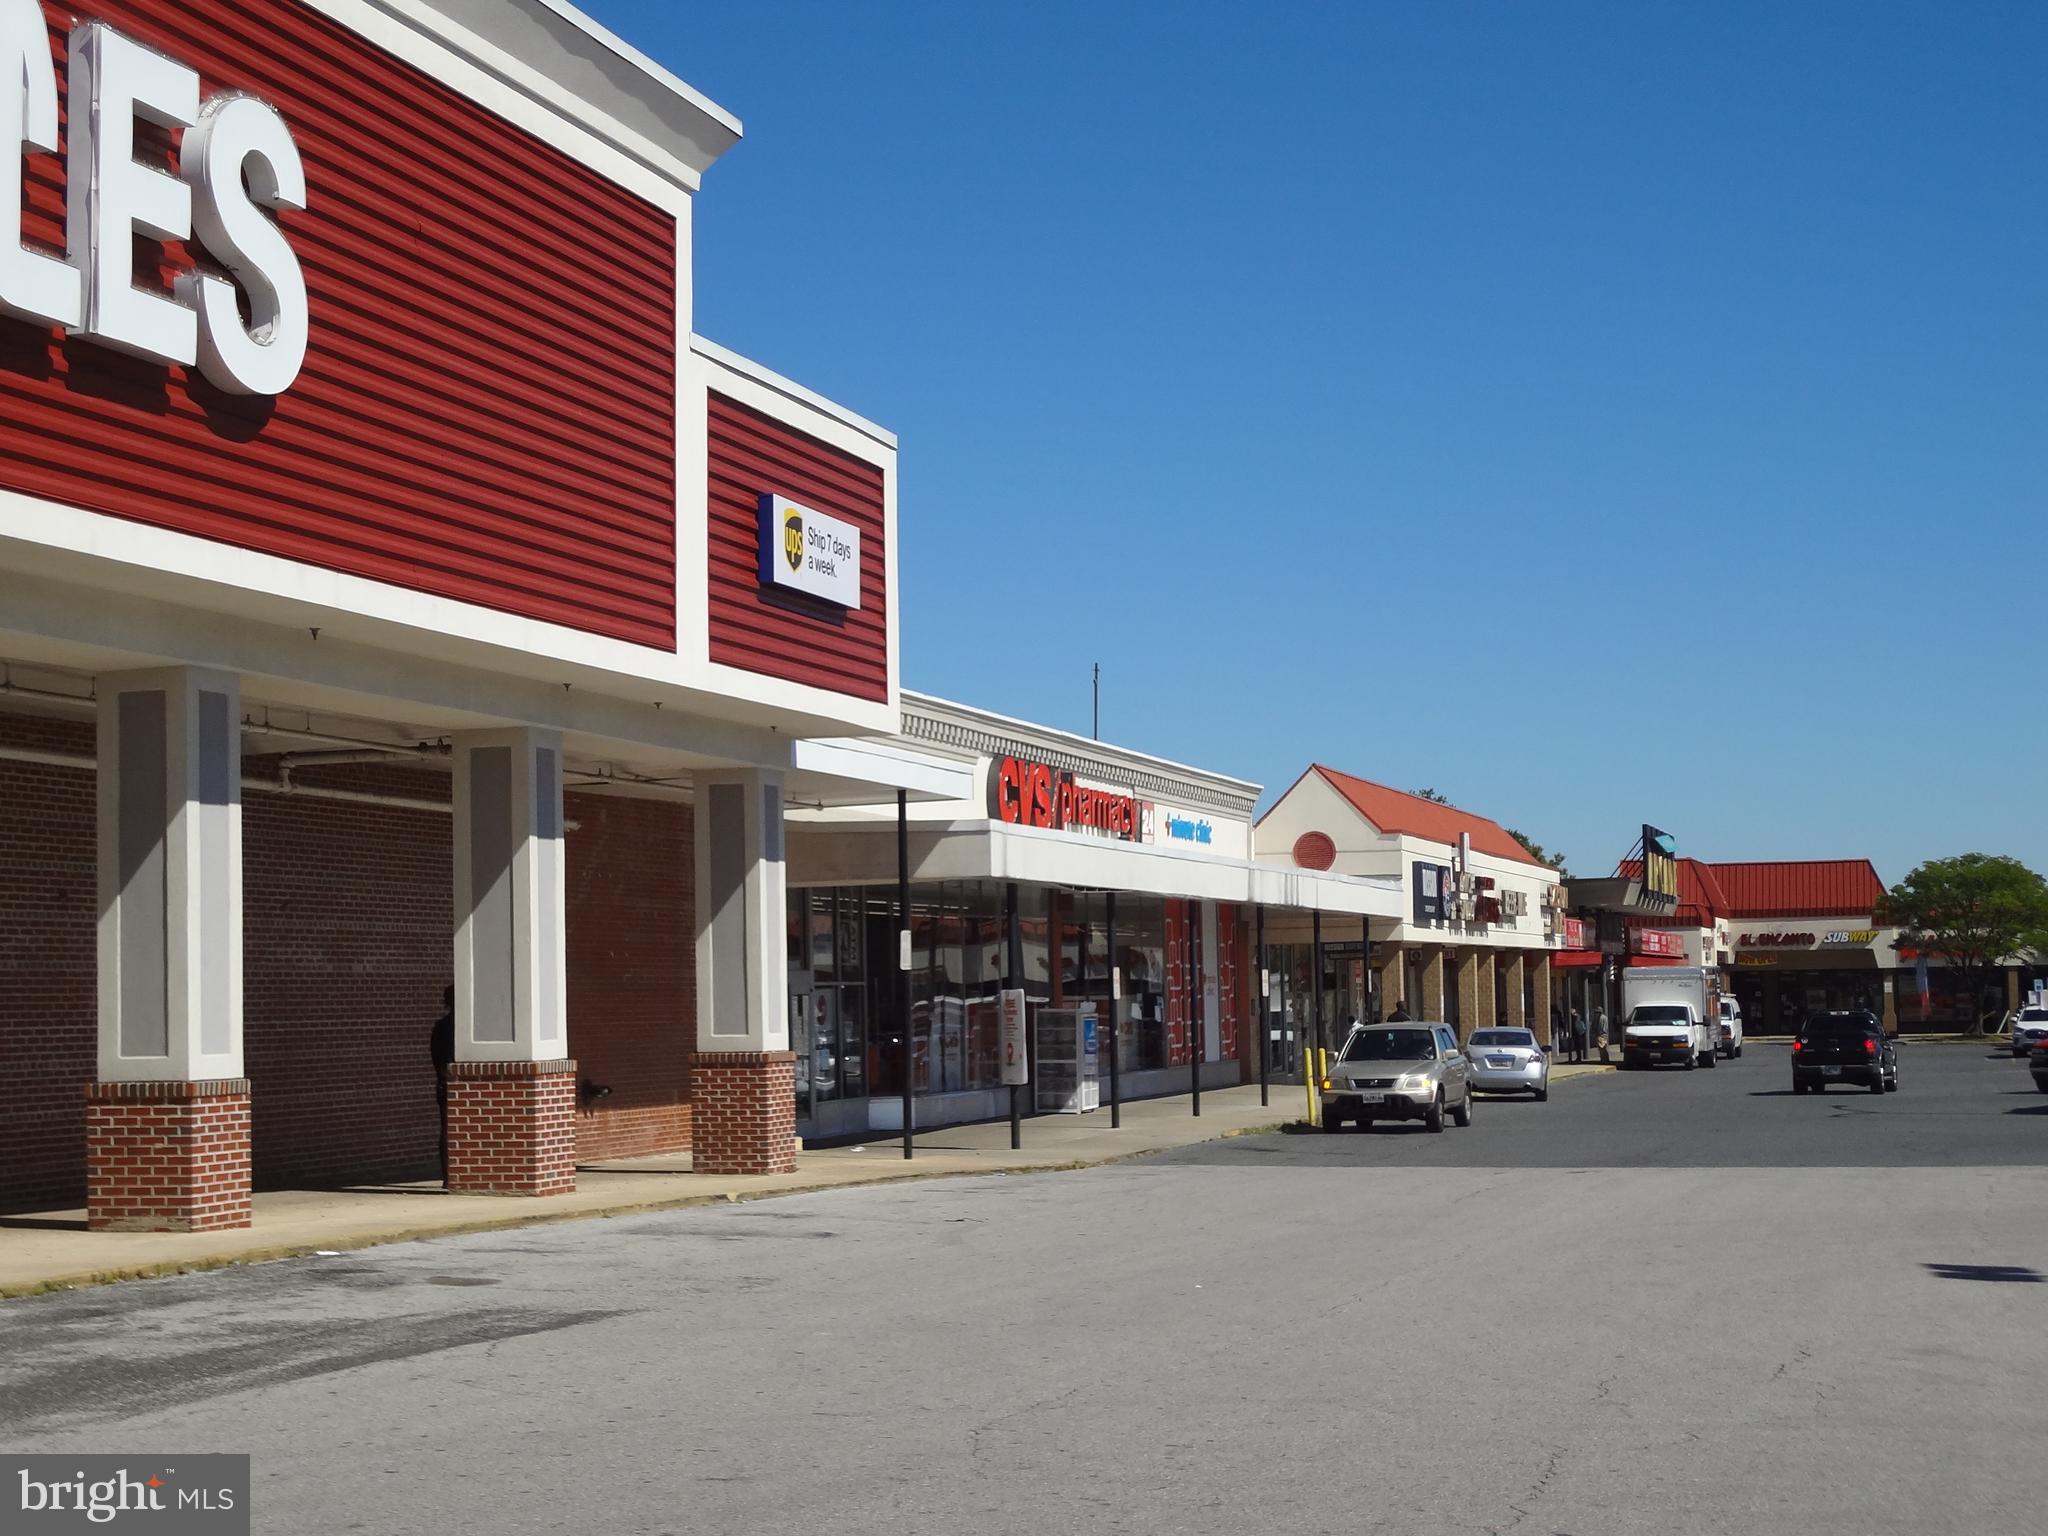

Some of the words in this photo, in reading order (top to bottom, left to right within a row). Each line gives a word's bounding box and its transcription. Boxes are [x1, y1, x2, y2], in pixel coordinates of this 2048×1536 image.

[785, 526, 803, 563] ups
[807, 526, 826, 553] Ship
[827, 534, 832, 551] 7
[833, 537, 851, 562] days
[808, 555, 813, 569] a
[815, 559, 837, 578] week.
[1823, 930, 1879, 943] SUBWAY
